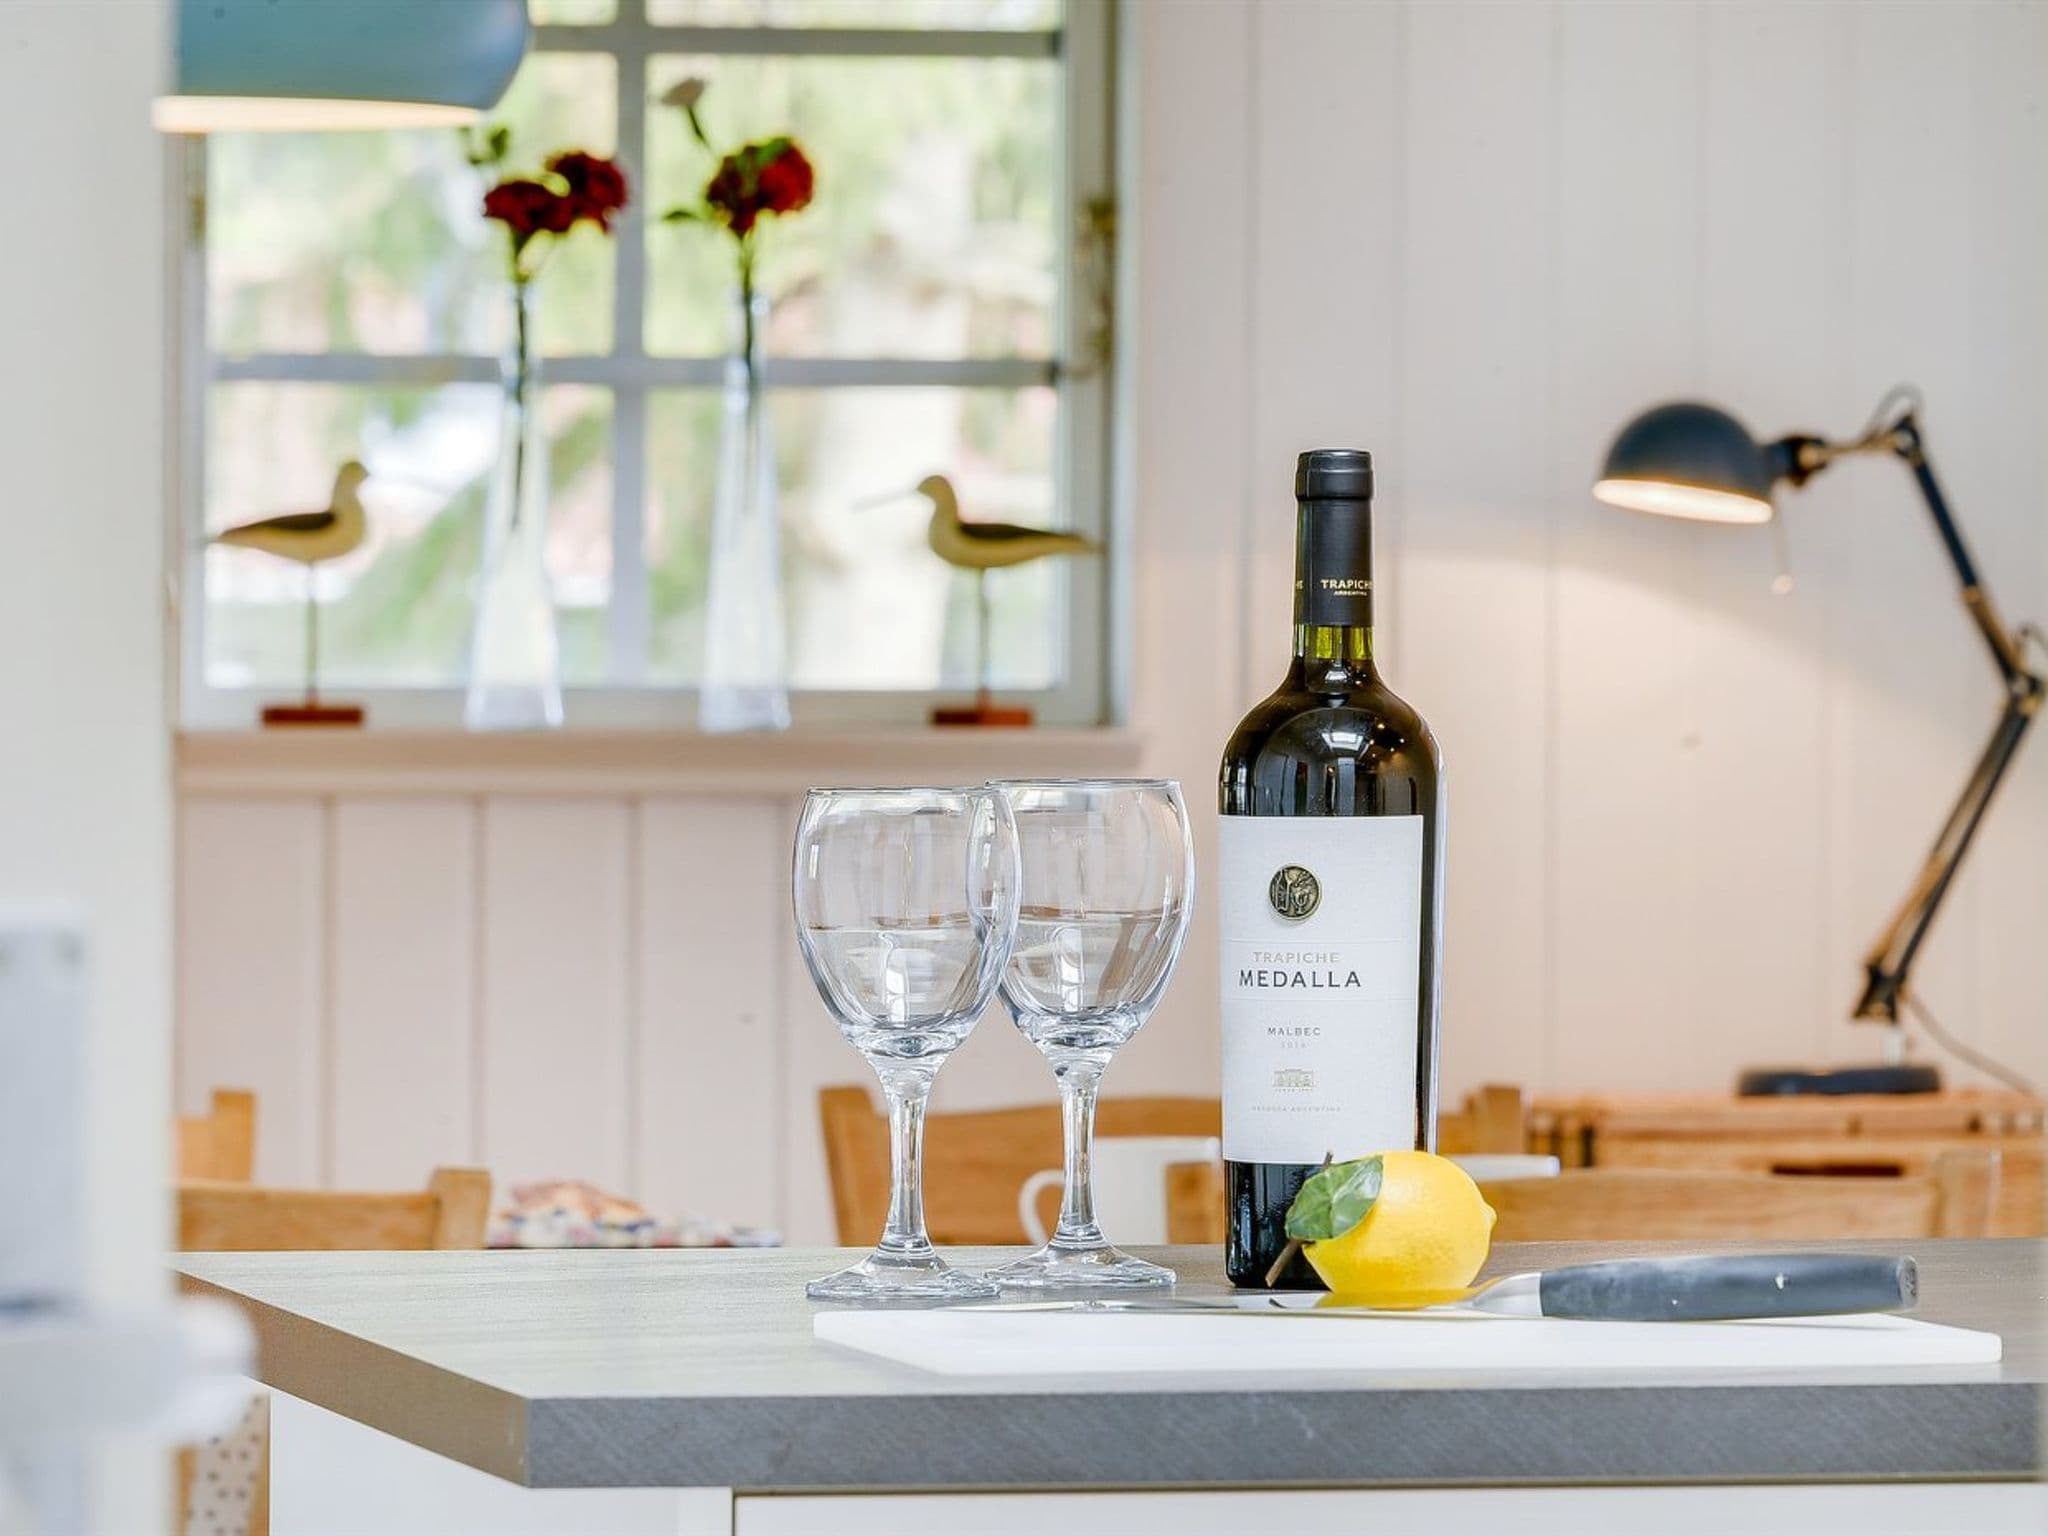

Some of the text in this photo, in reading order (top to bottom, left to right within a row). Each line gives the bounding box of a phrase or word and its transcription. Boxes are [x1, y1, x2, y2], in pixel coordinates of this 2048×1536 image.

[1252, 951, 1341, 964] TRAPICHE
[1238, 969, 1361, 988] MEDALLA
[1267, 1026, 1321, 1037] MALBEC
